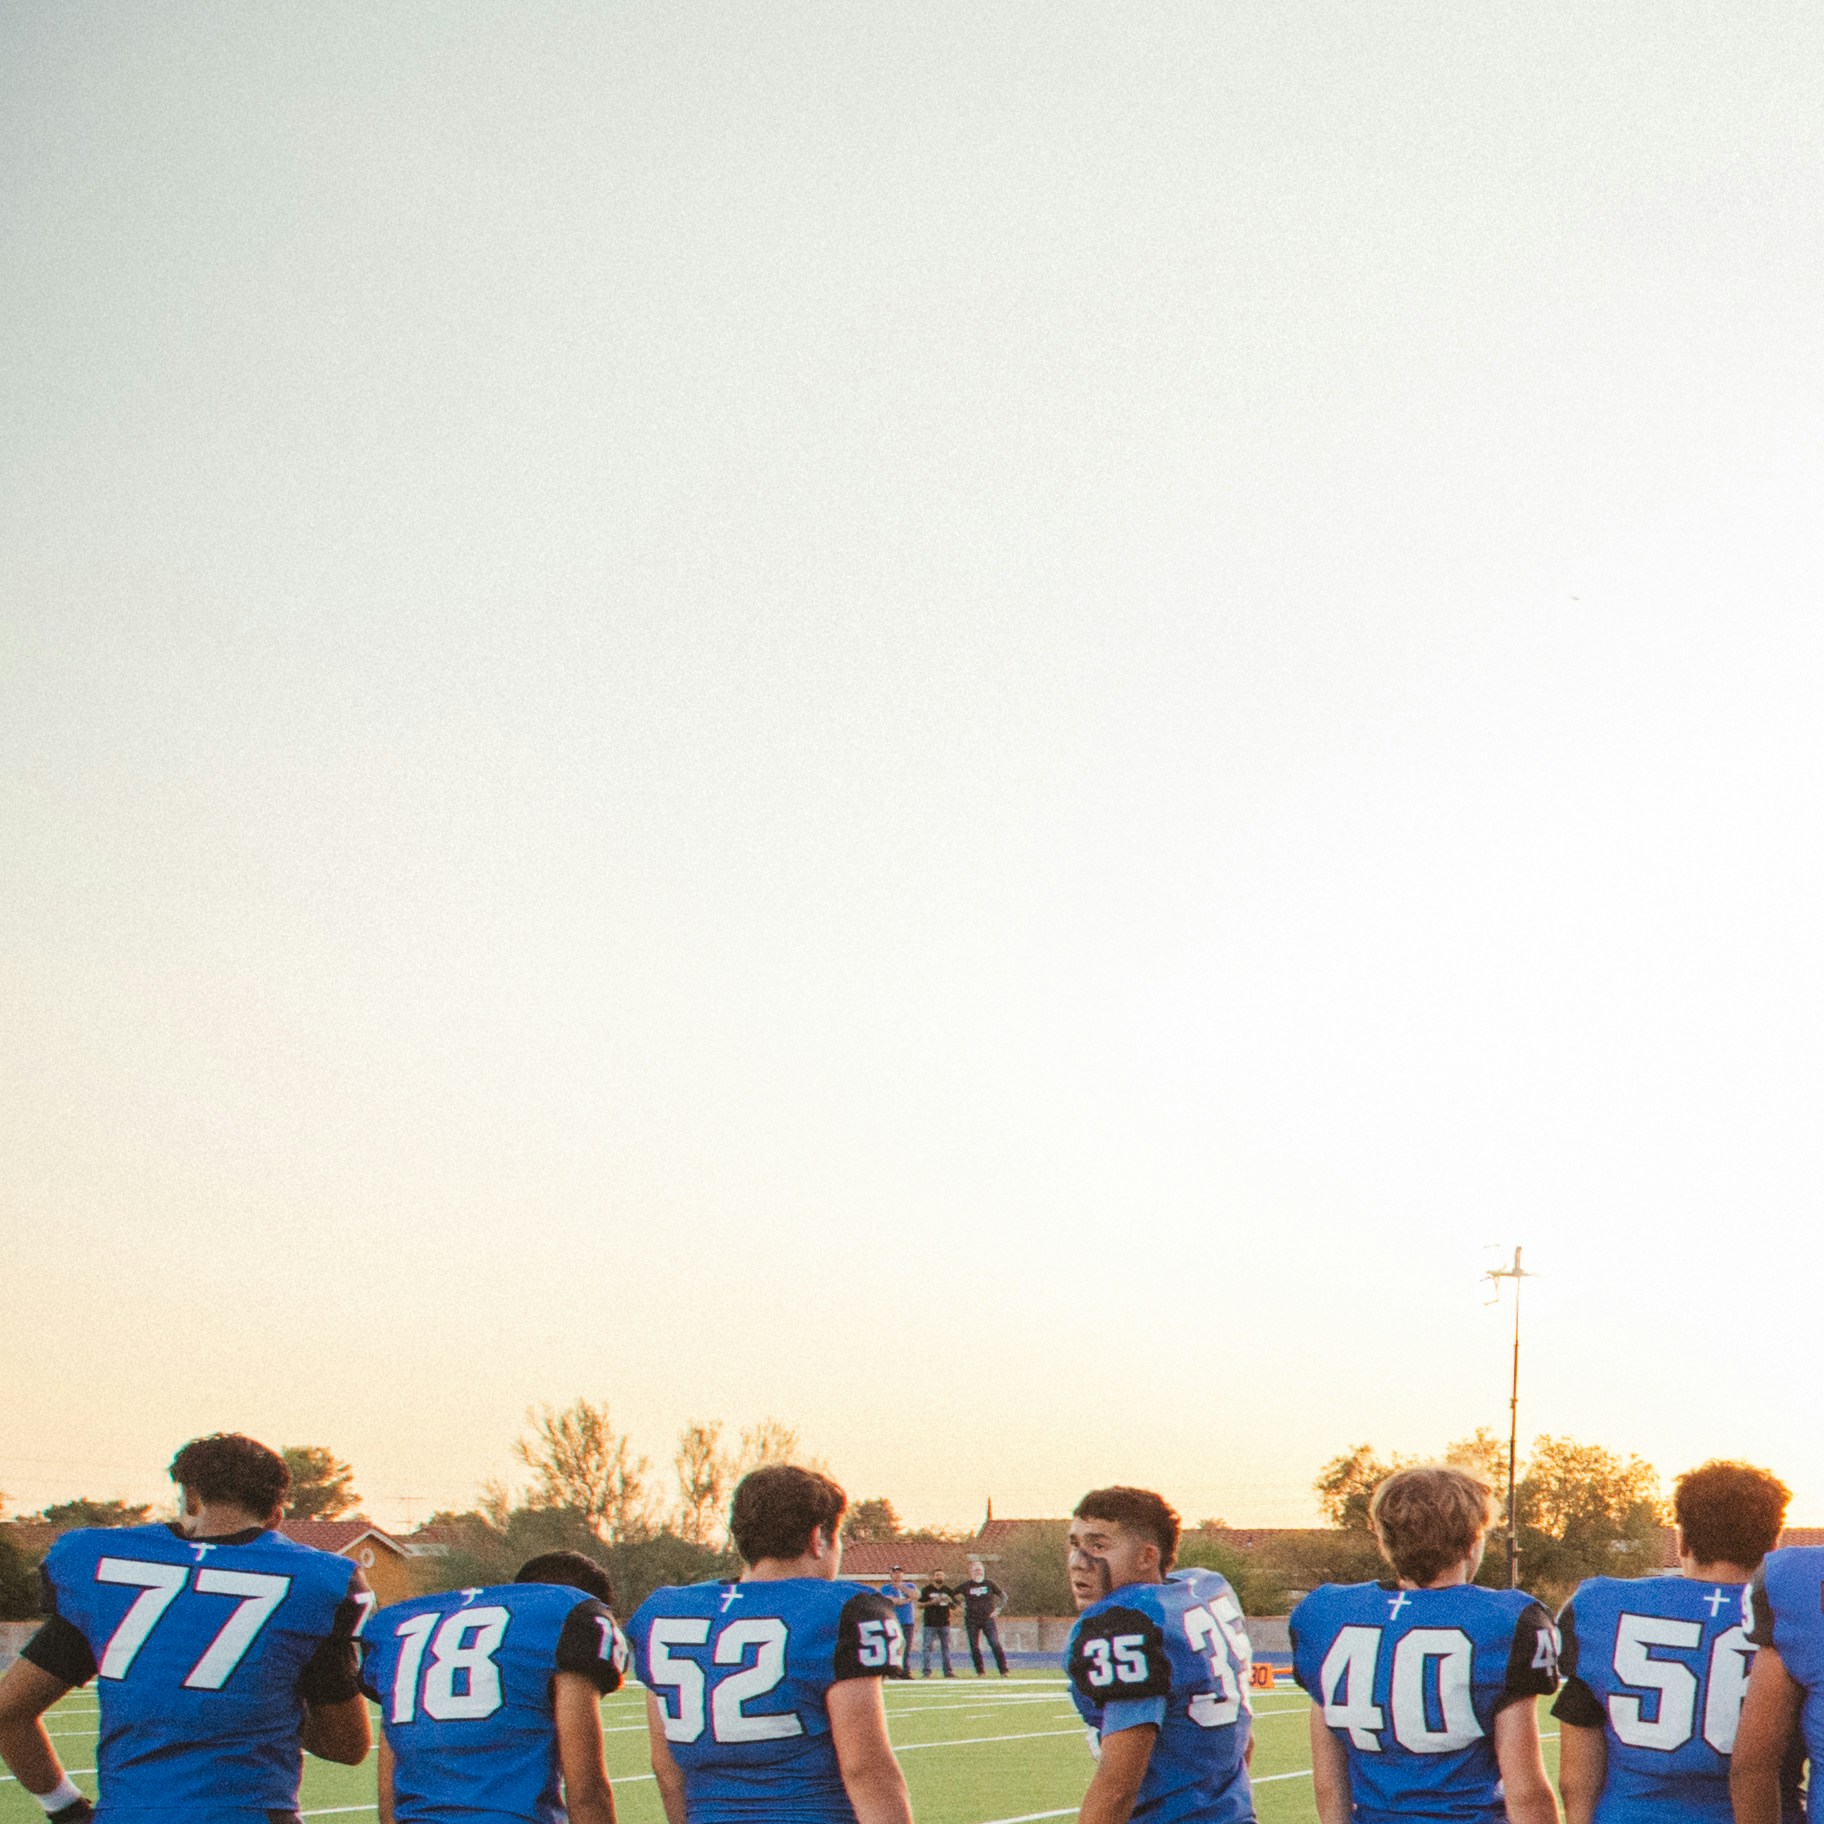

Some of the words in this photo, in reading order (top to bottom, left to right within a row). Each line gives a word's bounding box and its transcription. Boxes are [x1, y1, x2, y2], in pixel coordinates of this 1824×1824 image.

[95, 1556, 293, 1691] 77
[392, 1605, 512, 1725] 18
[649, 1617, 804, 1743] 52
[856, 1618, 902, 1668] 52
[1082, 1633, 1150, 1688] 35
[1320, 1624, 1485, 1753] 40
